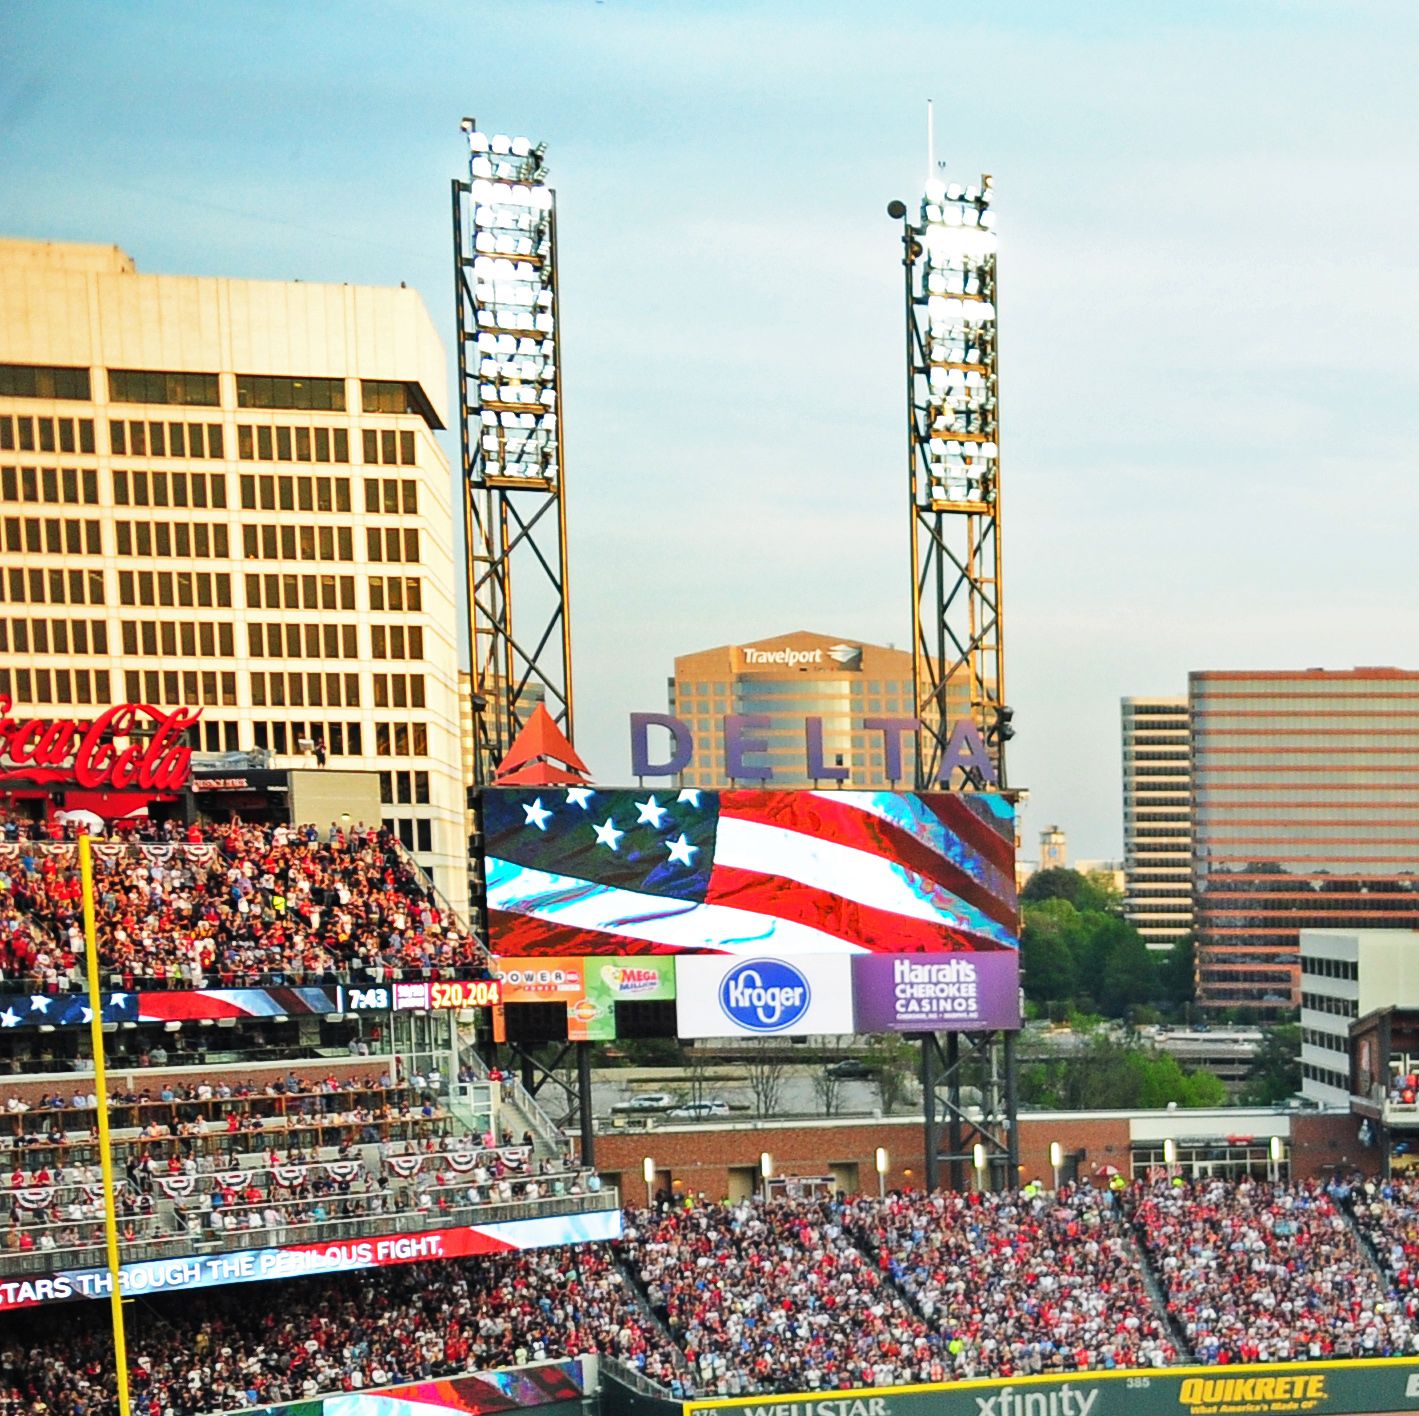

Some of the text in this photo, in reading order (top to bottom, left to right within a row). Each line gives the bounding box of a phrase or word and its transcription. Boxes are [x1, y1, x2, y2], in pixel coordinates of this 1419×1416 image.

[743, 647, 822, 667] Travelport
[630, 711, 999, 782] DELTA
[621, 968, 658, 983] MEGA
[893, 959, 977, 984] Harrah's
[348, 988, 389, 1009] 7:43
[430, 982, 500, 1009] $20,204
[728, 969, 805, 1024] Kroger
[894, 983, 977, 998] CHEROKEE
[895, 998, 978, 1013] CASINOS
[78, 1264, 200, 1297] THROUGH
[207, 1257, 256, 1281] THE
[260, 1246, 374, 1278] PERILOUS
[377, 1235, 444, 1260] FIGHT,
[1127, 1376, 1151, 1389] 385
[1179, 1374, 1328, 1405] QUIKRETE
